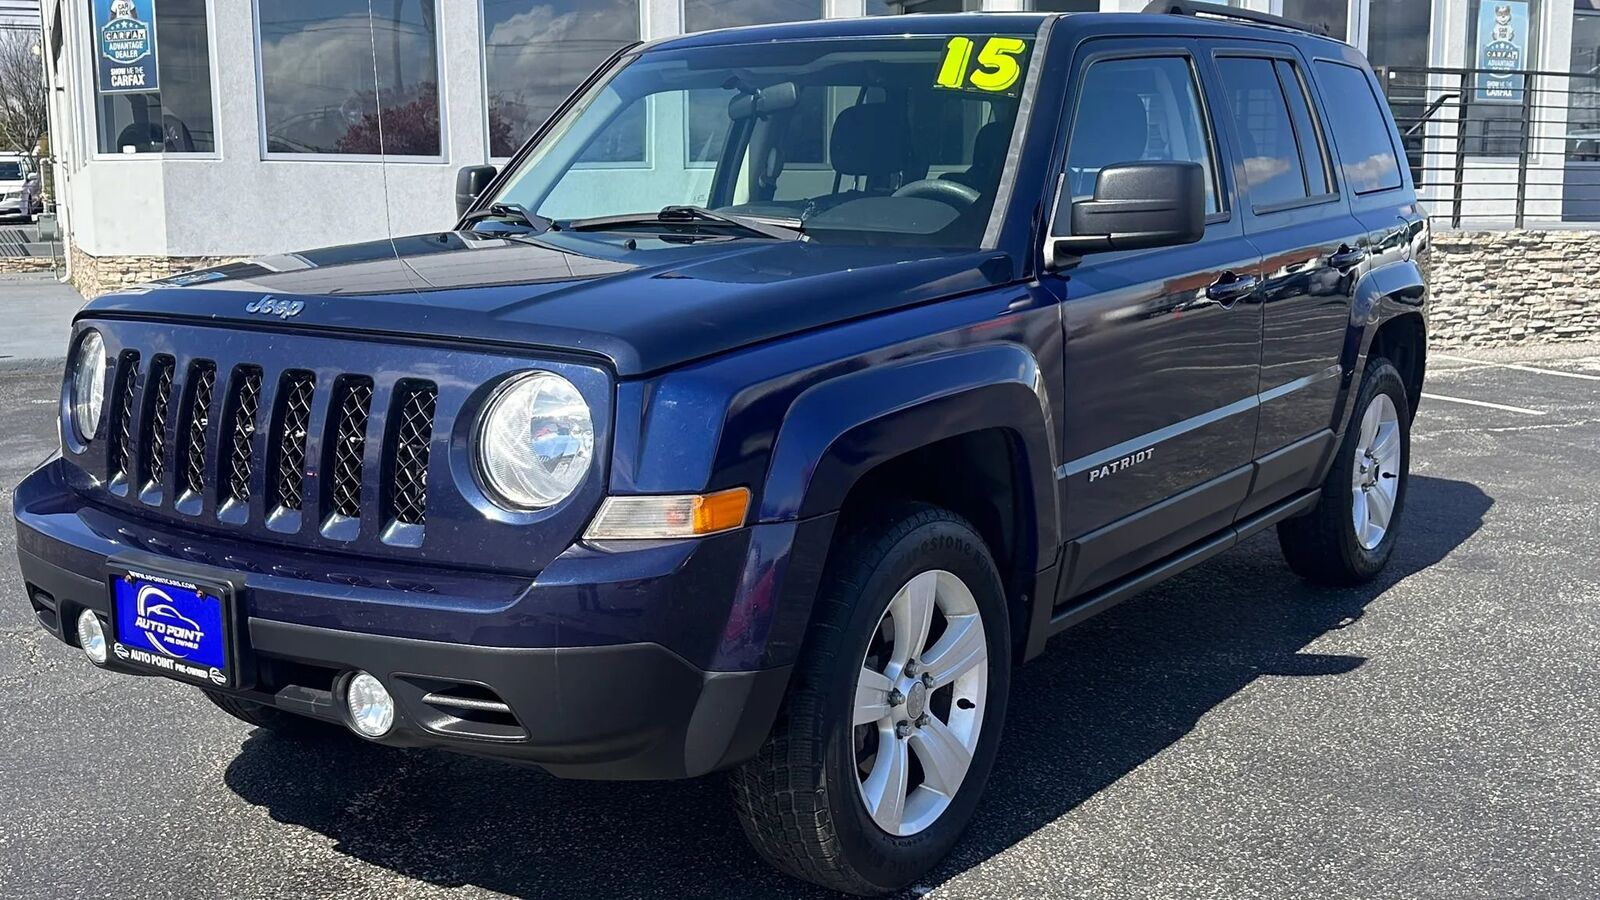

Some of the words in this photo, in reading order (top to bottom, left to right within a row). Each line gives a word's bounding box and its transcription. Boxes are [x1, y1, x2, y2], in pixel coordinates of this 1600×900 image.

[105, 30, 146, 40] CARFAX
[109, 41, 144, 50] ADVANTAGE
[115, 50, 138, 58] DEALER
[111, 67, 125, 75] SHOW
[937, 36, 1026, 92] 15
[111, 74, 145, 87] CARFAX
[245, 294, 305, 320] Jeep
[1089, 448, 1155, 482] PATRIOT
[135, 617, 166, 634] AUTO
[166, 624, 204, 642] POINT
[163, 636, 175, 644] PRE
[175, 638, 199, 650] OWNED
[131, 650, 152, 664] AUTO
[152, 654, 175, 670] POINT
[175, 663, 208, 679] PRE-OWNED
